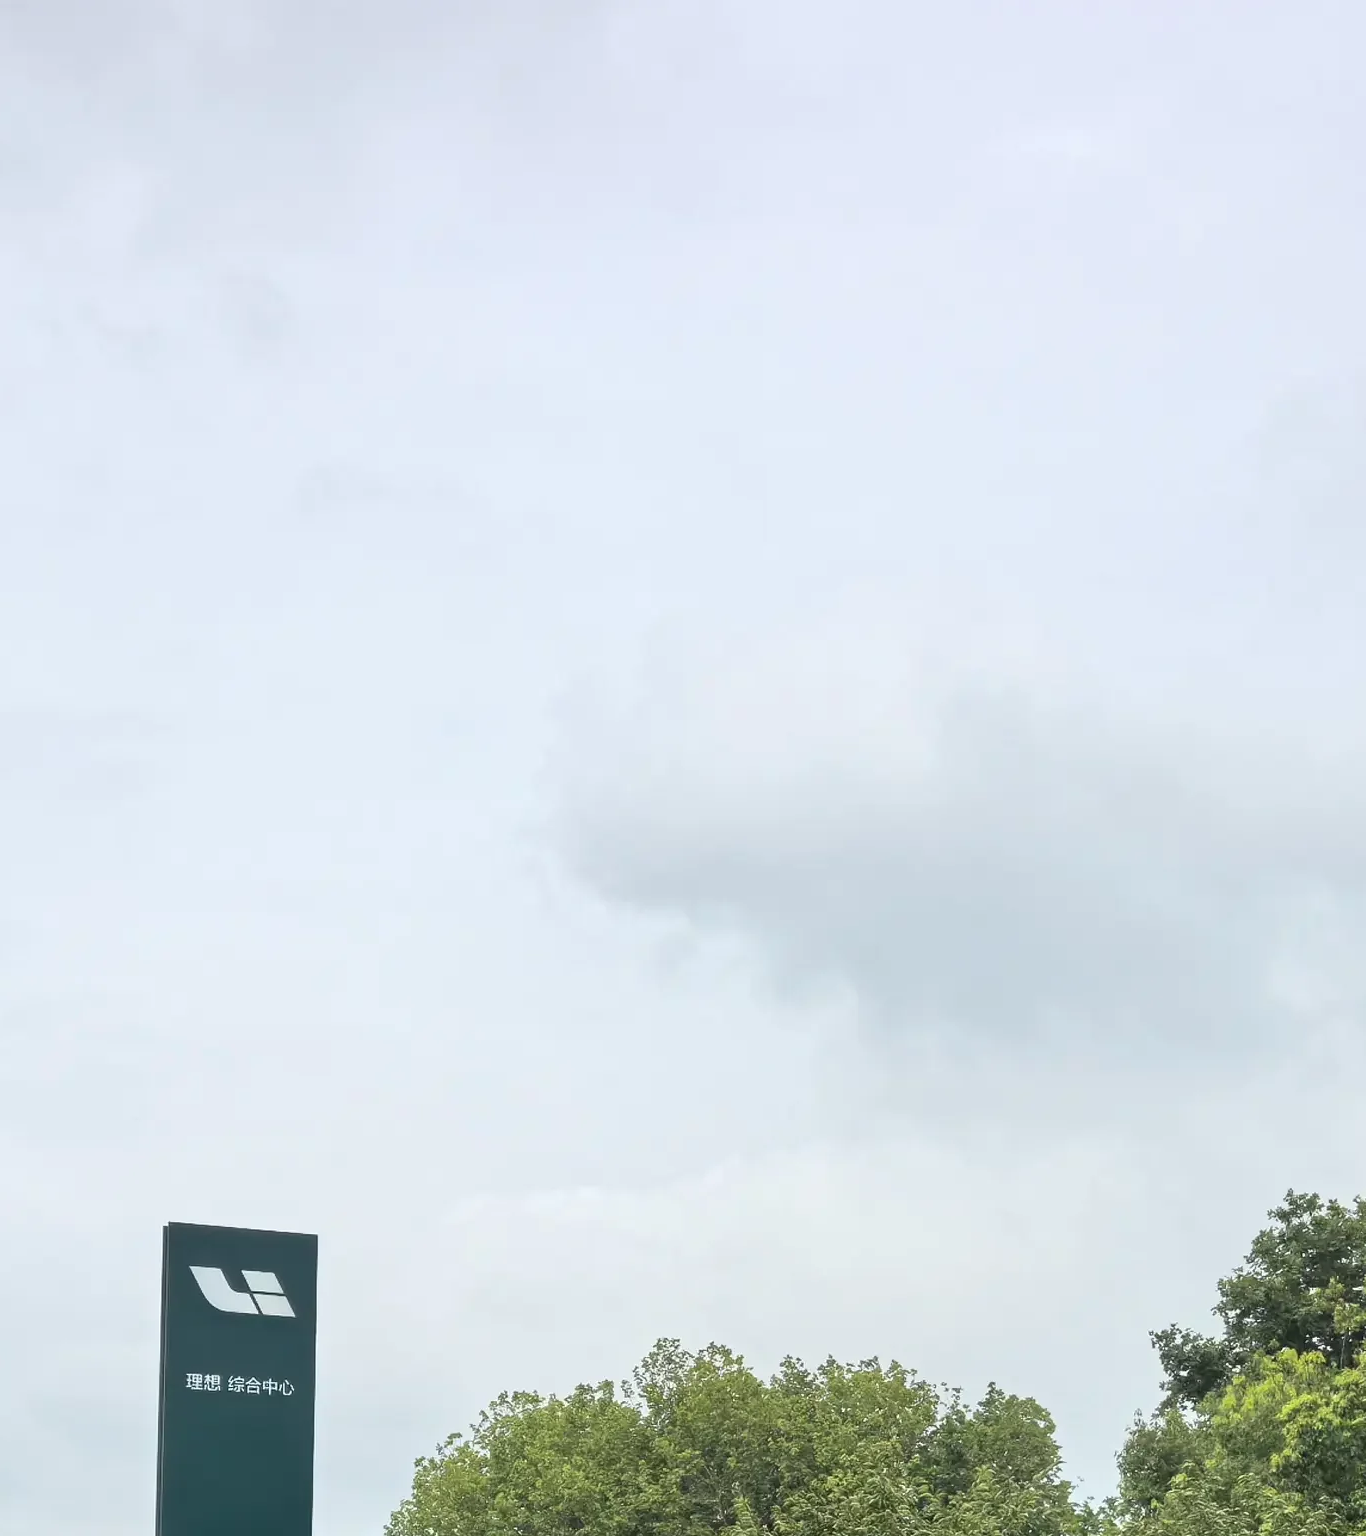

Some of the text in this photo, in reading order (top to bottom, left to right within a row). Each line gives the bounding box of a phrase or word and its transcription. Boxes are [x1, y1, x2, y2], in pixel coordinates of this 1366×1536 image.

[185, 1373, 295, 1396] 理想 综合中心
